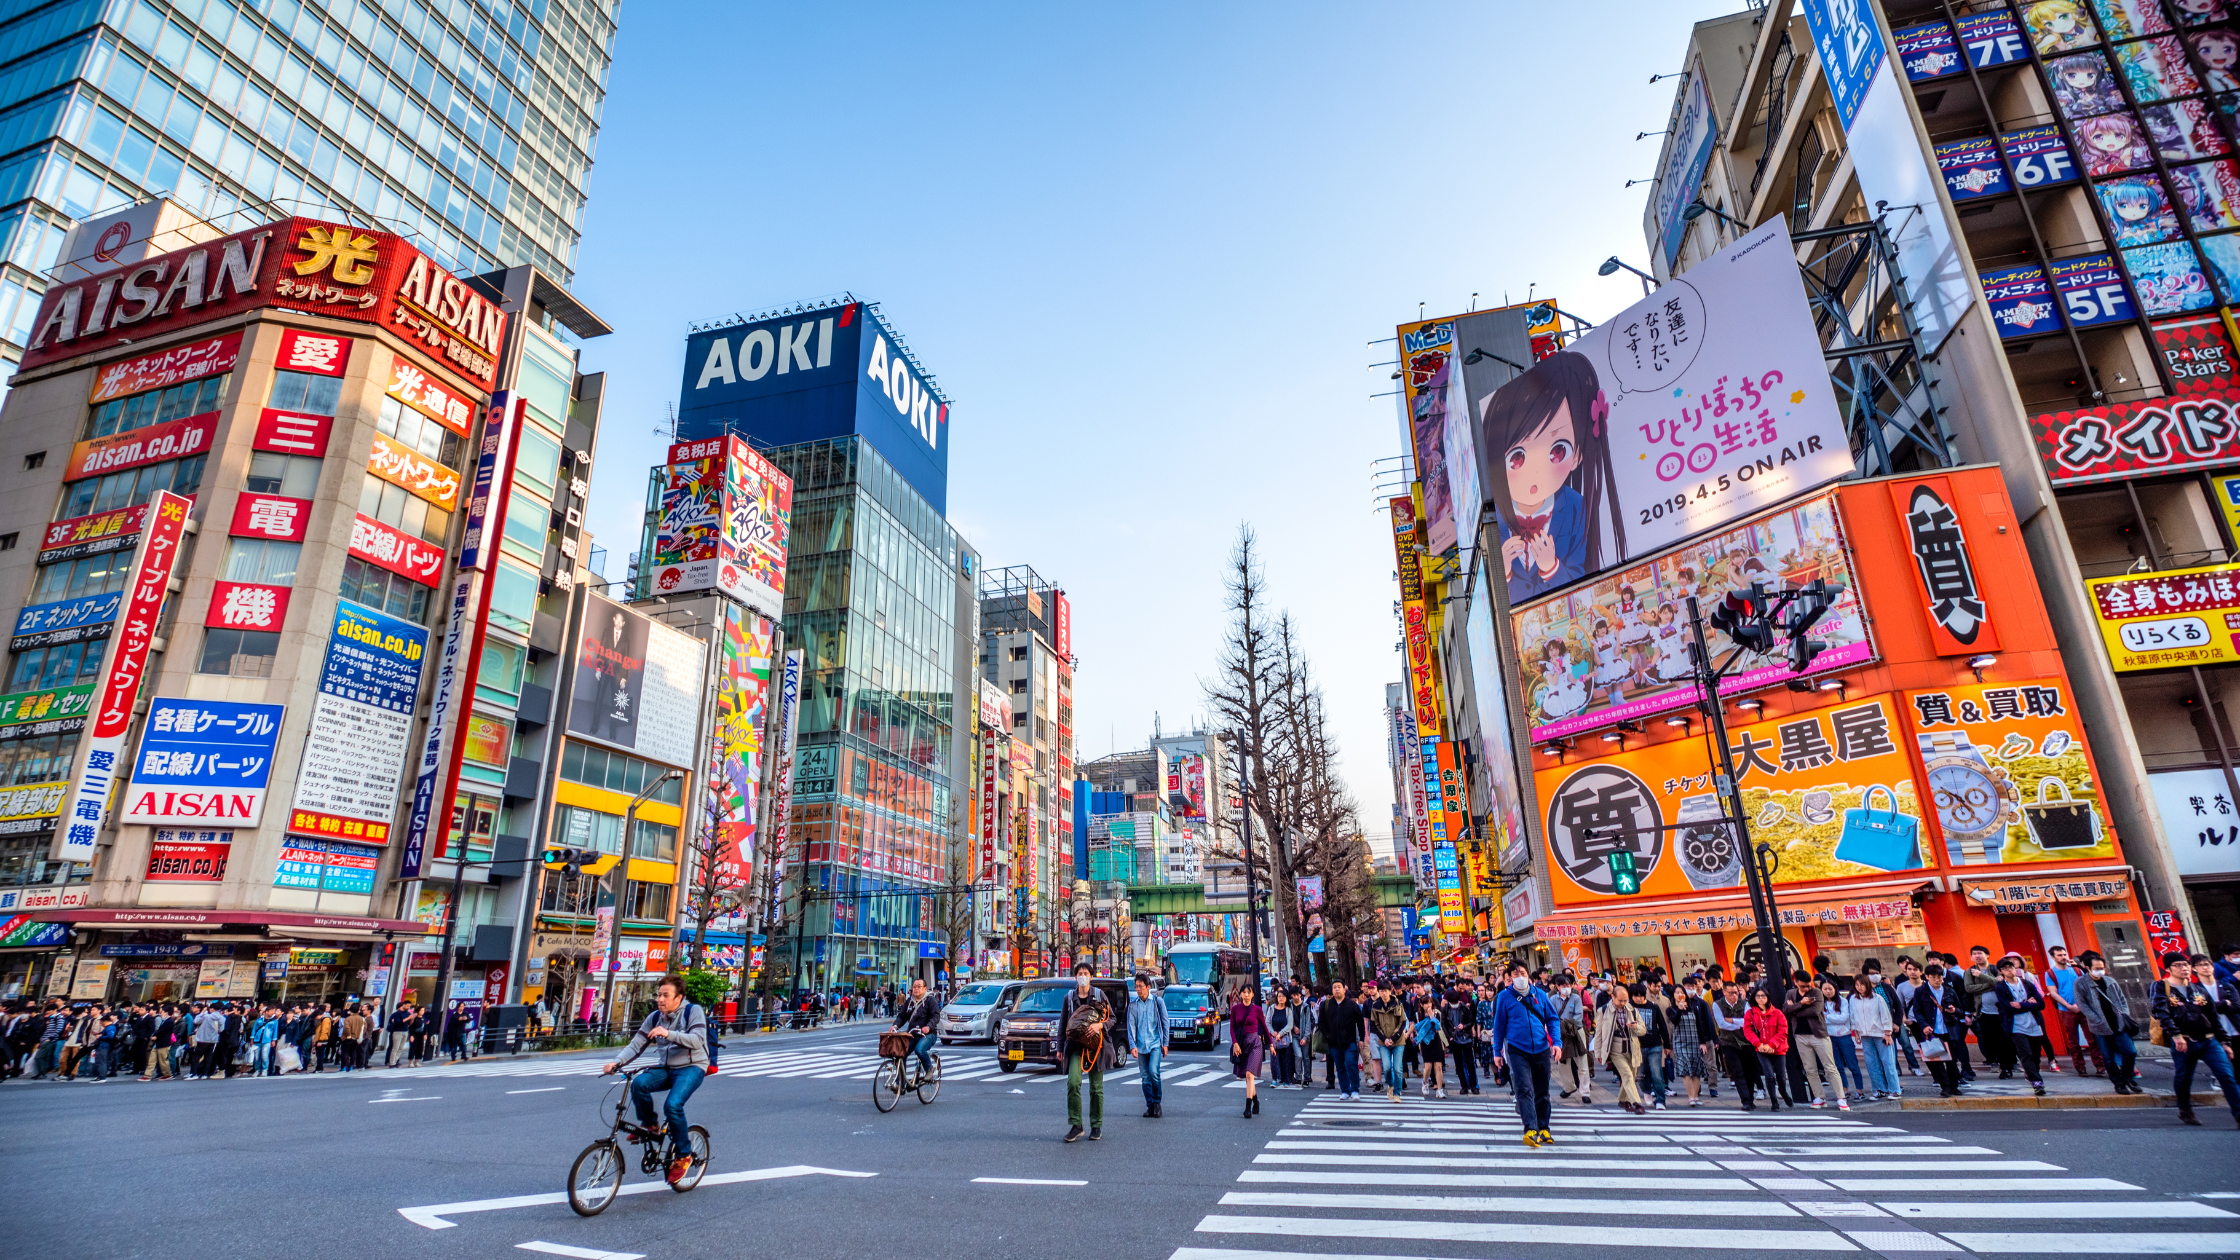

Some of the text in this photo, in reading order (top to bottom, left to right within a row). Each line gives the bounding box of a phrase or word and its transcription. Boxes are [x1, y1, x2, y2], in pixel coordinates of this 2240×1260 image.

[1906, 52, 1957, 68] AMENITY
[1968, 35, 2023, 67] 7F
[1913, 59, 1957, 74] DREAM
[1846, 47, 1877, 119] 5F・6F
[1947, 168, 2002, 184] AMENITY
[2015, 150, 2071, 185] 6F
[1955, 175, 1999, 192] DREAM
[293, 226, 378, 286] 光
[1737, 232, 1776, 260] KADOKAWA
[29, 230, 273, 351] AISAN
[276, 279, 377, 309] ネットワーク
[2137, 272, 2205, 301] 3.29
[400, 254, 504, 356] AISAN
[1995, 301, 2052, 318] AMENITY
[2003, 308, 2050, 325] DREAM
[2069, 285, 2126, 321] 5F
[1664, 297, 1688, 345] 友達に
[1404, 322, 1454, 353] MED
[1644, 312, 1670, 373] なりたい
[696, 318, 833, 390] AOKI
[2164, 345, 2225, 366] Poker
[2171, 358, 2232, 379] Stars
[94, 364, 133, 399] 光
[389, 365, 469, 428] 光通信
[867, 333, 937, 450] AOKI
[1639, 369, 1784, 447] ひとりぼっちの
[82, 427, 203, 473] aisan.co.jp
[676, 441, 721, 461] 免税店
[370, 439, 457, 500] ネットワーク
[1640, 434, 1823, 525] 2019.4.5 ON AIR
[48, 524, 71, 543] 3F
[350, 517, 441, 575] 配線パーツ
[556, 476, 588, 592] 坂口電熱
[687, 572, 709, 580] Tax-free
[690, 565, 709, 573] Japan.
[1906, 502, 1986, 628] 質
[19, 610, 44, 630] 2F
[103, 501, 183, 725] 光・ケーブル・ネットワーク
[1813, 619, 1843, 637] cafe
[337, 619, 422, 661] aisan.co.jp
[2128, 622, 2202, 646] りらくる
[582, 654, 615, 677] AGA
[585, 637, 644, 671] Change!
[2123, 647, 2224, 667] 秋葉原中央通り店
[425, 583, 469, 766] 各種ケーブル・ネットワーク機器
[785, 656, 798, 704] AKKY
[154, 708, 275, 735] 各種ケーブル
[1914, 686, 2065, 727] 質&買取
[1403, 714, 1419, 750] AKKY
[1429, 735, 1441, 743] 中古
[1729, 702, 1896, 783] 大黒屋
[142, 751, 264, 778] 配線パーツ
[800, 767, 828, 777] OPEN
[802, 750, 827, 765] 24h
[68, 750, 115, 846] 愛三電機
[130, 791, 255, 818] AISAN
[1442, 769, 1459, 813] 吉野家
[2190, 793, 2231, 816] 喫茶
[984, 791, 993, 831] カラオケ
[1411, 762, 1429, 852] Tax-free Shop
[295, 813, 386, 838] 各社 特約 在庫 直販
[405, 779, 431, 866] AISAN
[1558, 775, 1657, 881] 質
[150, 854, 227, 878] aisan.co.jp
[1437, 860, 1456, 868] DVD
[1448, 870, 1457, 878] 中古
[1998, 880, 2127, 901] 1階にて高価買取中
[115, 912, 206, 922] http://www.aisan.co.jp
[1537, 900, 1910, 938] 高価買取 無料査定
[2150, 913, 2173, 928] 4F
[649, 949, 664, 959] au
[1680, 959, 1708, 968] 大黒屋
